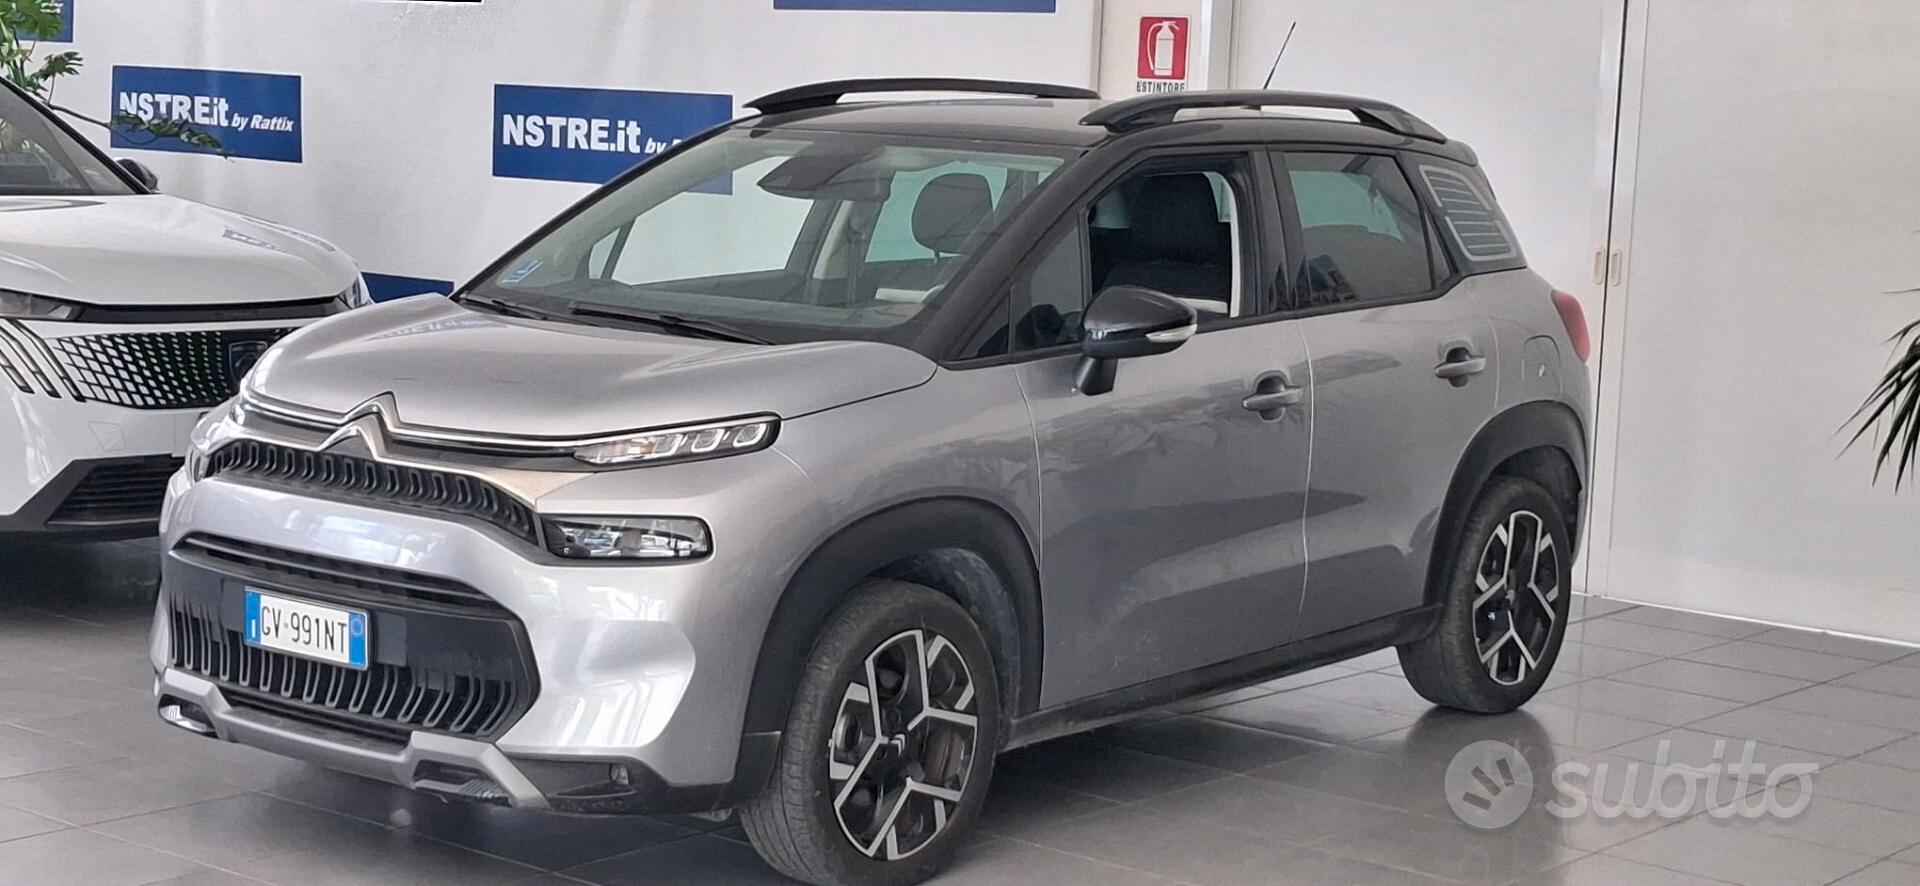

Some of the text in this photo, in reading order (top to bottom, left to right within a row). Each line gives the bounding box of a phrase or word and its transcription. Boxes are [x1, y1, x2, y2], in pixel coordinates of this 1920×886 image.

[1136, 81, 1185, 93] ESTINTORE
[231, 112, 249, 132] by
[250, 114, 294, 132] Rattix
[502, 114, 641, 154] NSTRE.it
